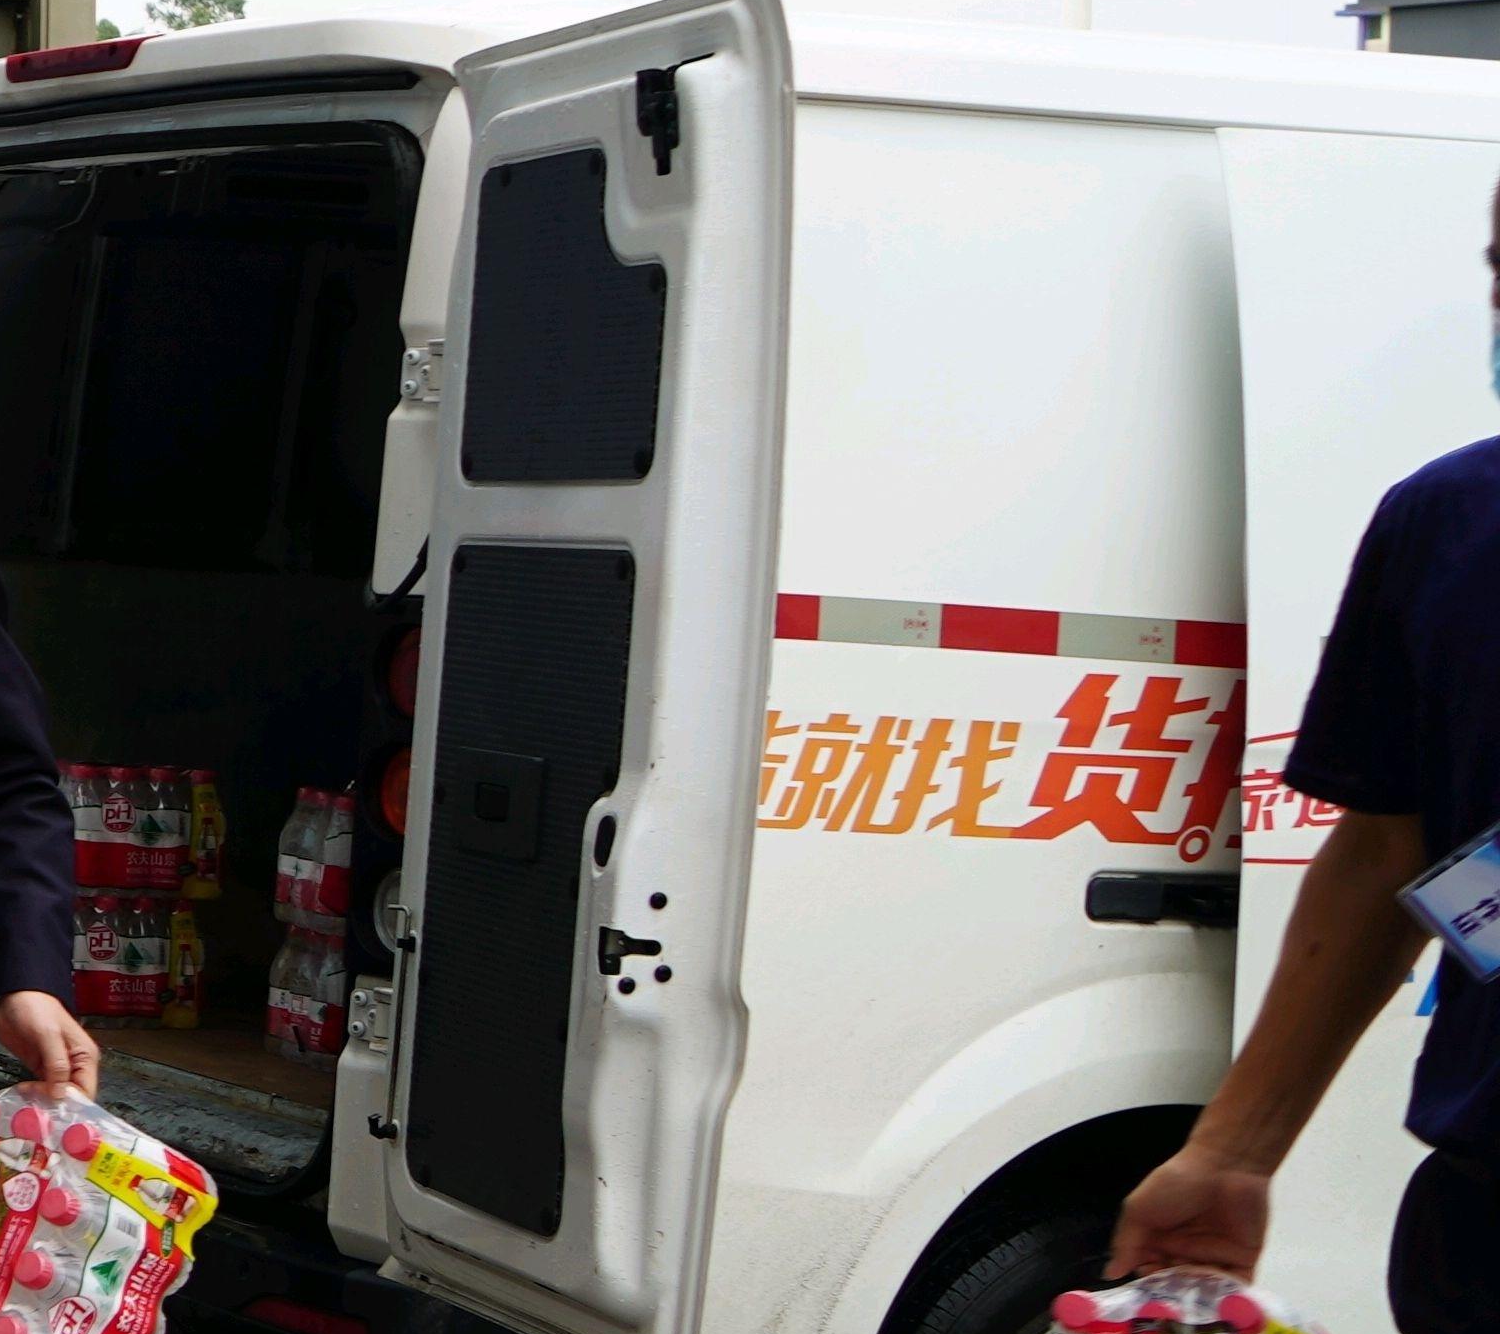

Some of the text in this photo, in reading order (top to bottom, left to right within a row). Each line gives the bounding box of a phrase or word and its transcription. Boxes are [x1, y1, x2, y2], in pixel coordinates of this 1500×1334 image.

[103, 802, 131, 827] pH
[126, 850, 177, 867] 农夫山泉
[88, 931, 115, 954] pH
[108, 978, 157, 994] 农夫山泉
[116, 1251, 160, 1334] 农夫山泉
